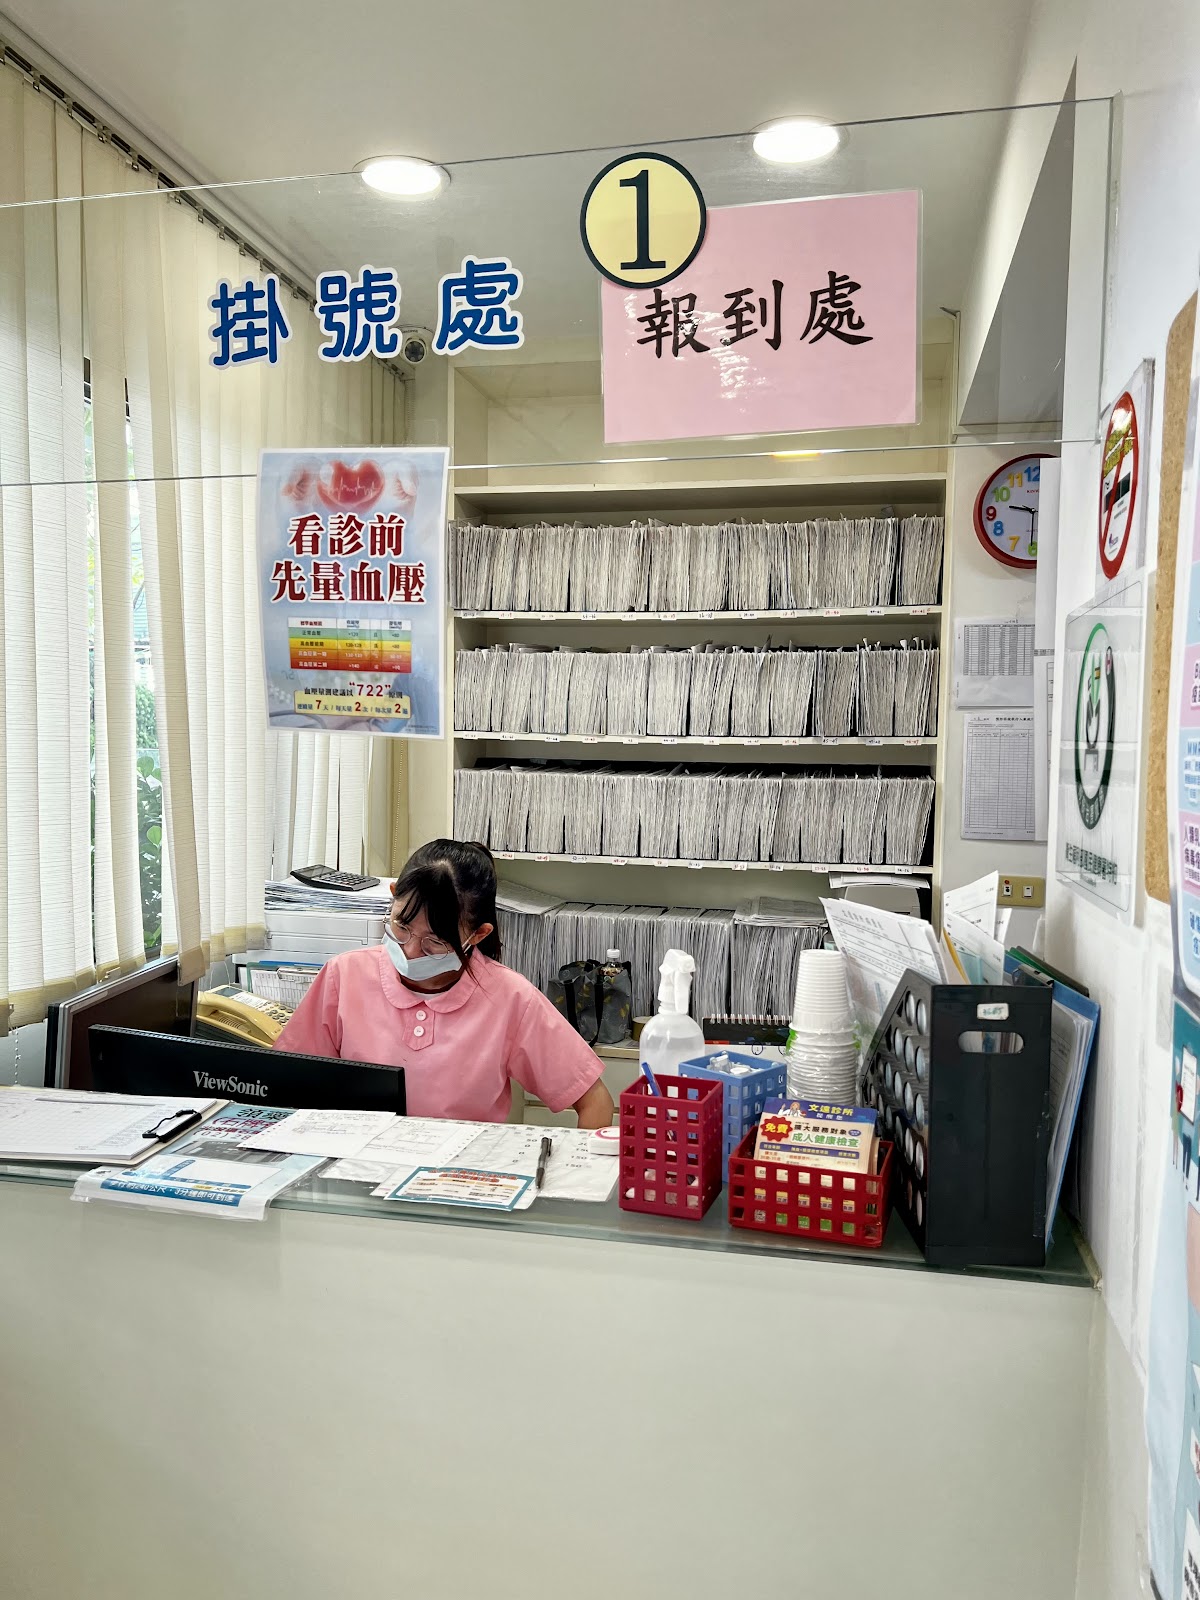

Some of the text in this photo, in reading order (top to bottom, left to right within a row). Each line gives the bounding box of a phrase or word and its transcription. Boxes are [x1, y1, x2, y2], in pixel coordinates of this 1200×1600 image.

[619, 169, 666, 271] 1
[211, 259, 521, 366] 掛號處
[637, 271, 874, 358] 報到處
[1007, 473, 1023, 488] 11
[991, 486, 1011, 502] 10
[985, 505, 997, 521] 9
[288, 513, 405, 556] 看診前
[993, 521, 1004, 537] 8
[1008, 536, 1020, 552] 7
[270, 561, 426, 604] 先量血壓
[315, 700, 322, 710] 7
[354, 701, 362, 712] 2
[394, 703, 401, 714] 2
[193, 1070, 269, 1097] ViewSonic
[765, 1122, 789, 1134] 免費
[794, 1124, 847, 1135] 擴大服務對象
[792, 1133, 860, 1148] 成人健康檢查
